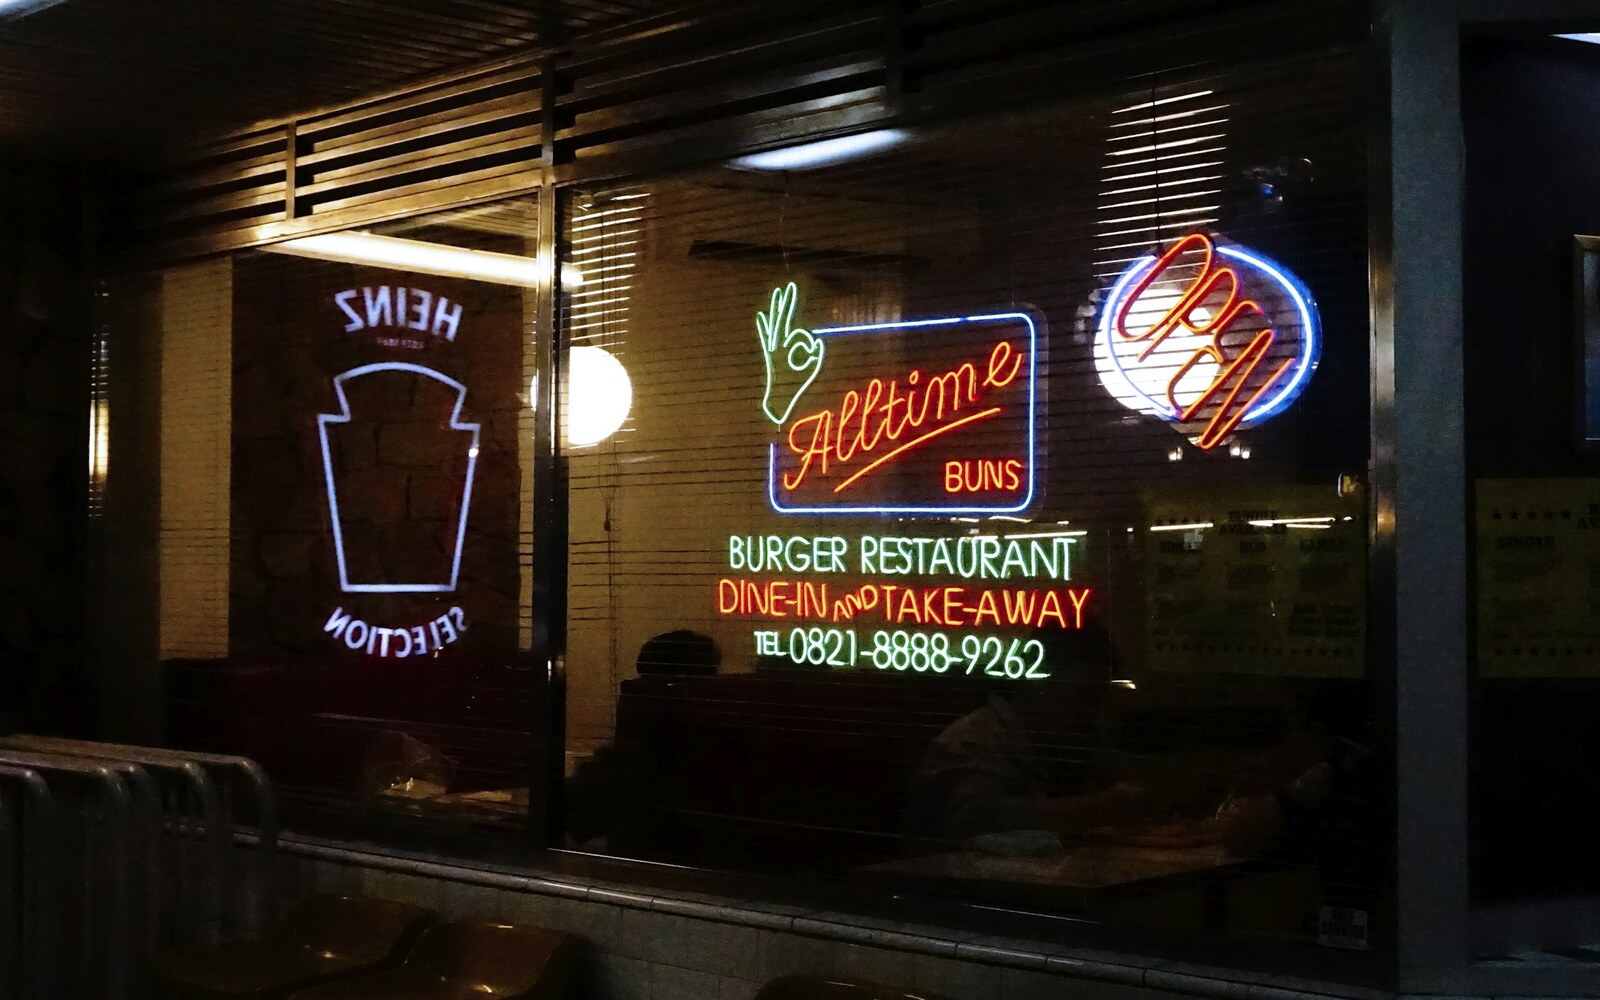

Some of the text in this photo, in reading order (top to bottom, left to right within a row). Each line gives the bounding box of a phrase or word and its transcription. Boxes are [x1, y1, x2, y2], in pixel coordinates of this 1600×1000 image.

[1116, 233, 1295, 449] Open
[783, 341, 1024, 491] Alltime
[944, 459, 1023, 493] BUNS
[729, 535, 1077, 581] BURGER RESTAURANT
[719, 578, 1091, 629] DINE-IN AND TAKE-AWAY
[789, 627, 1051, 679] 0821-8888-9262
